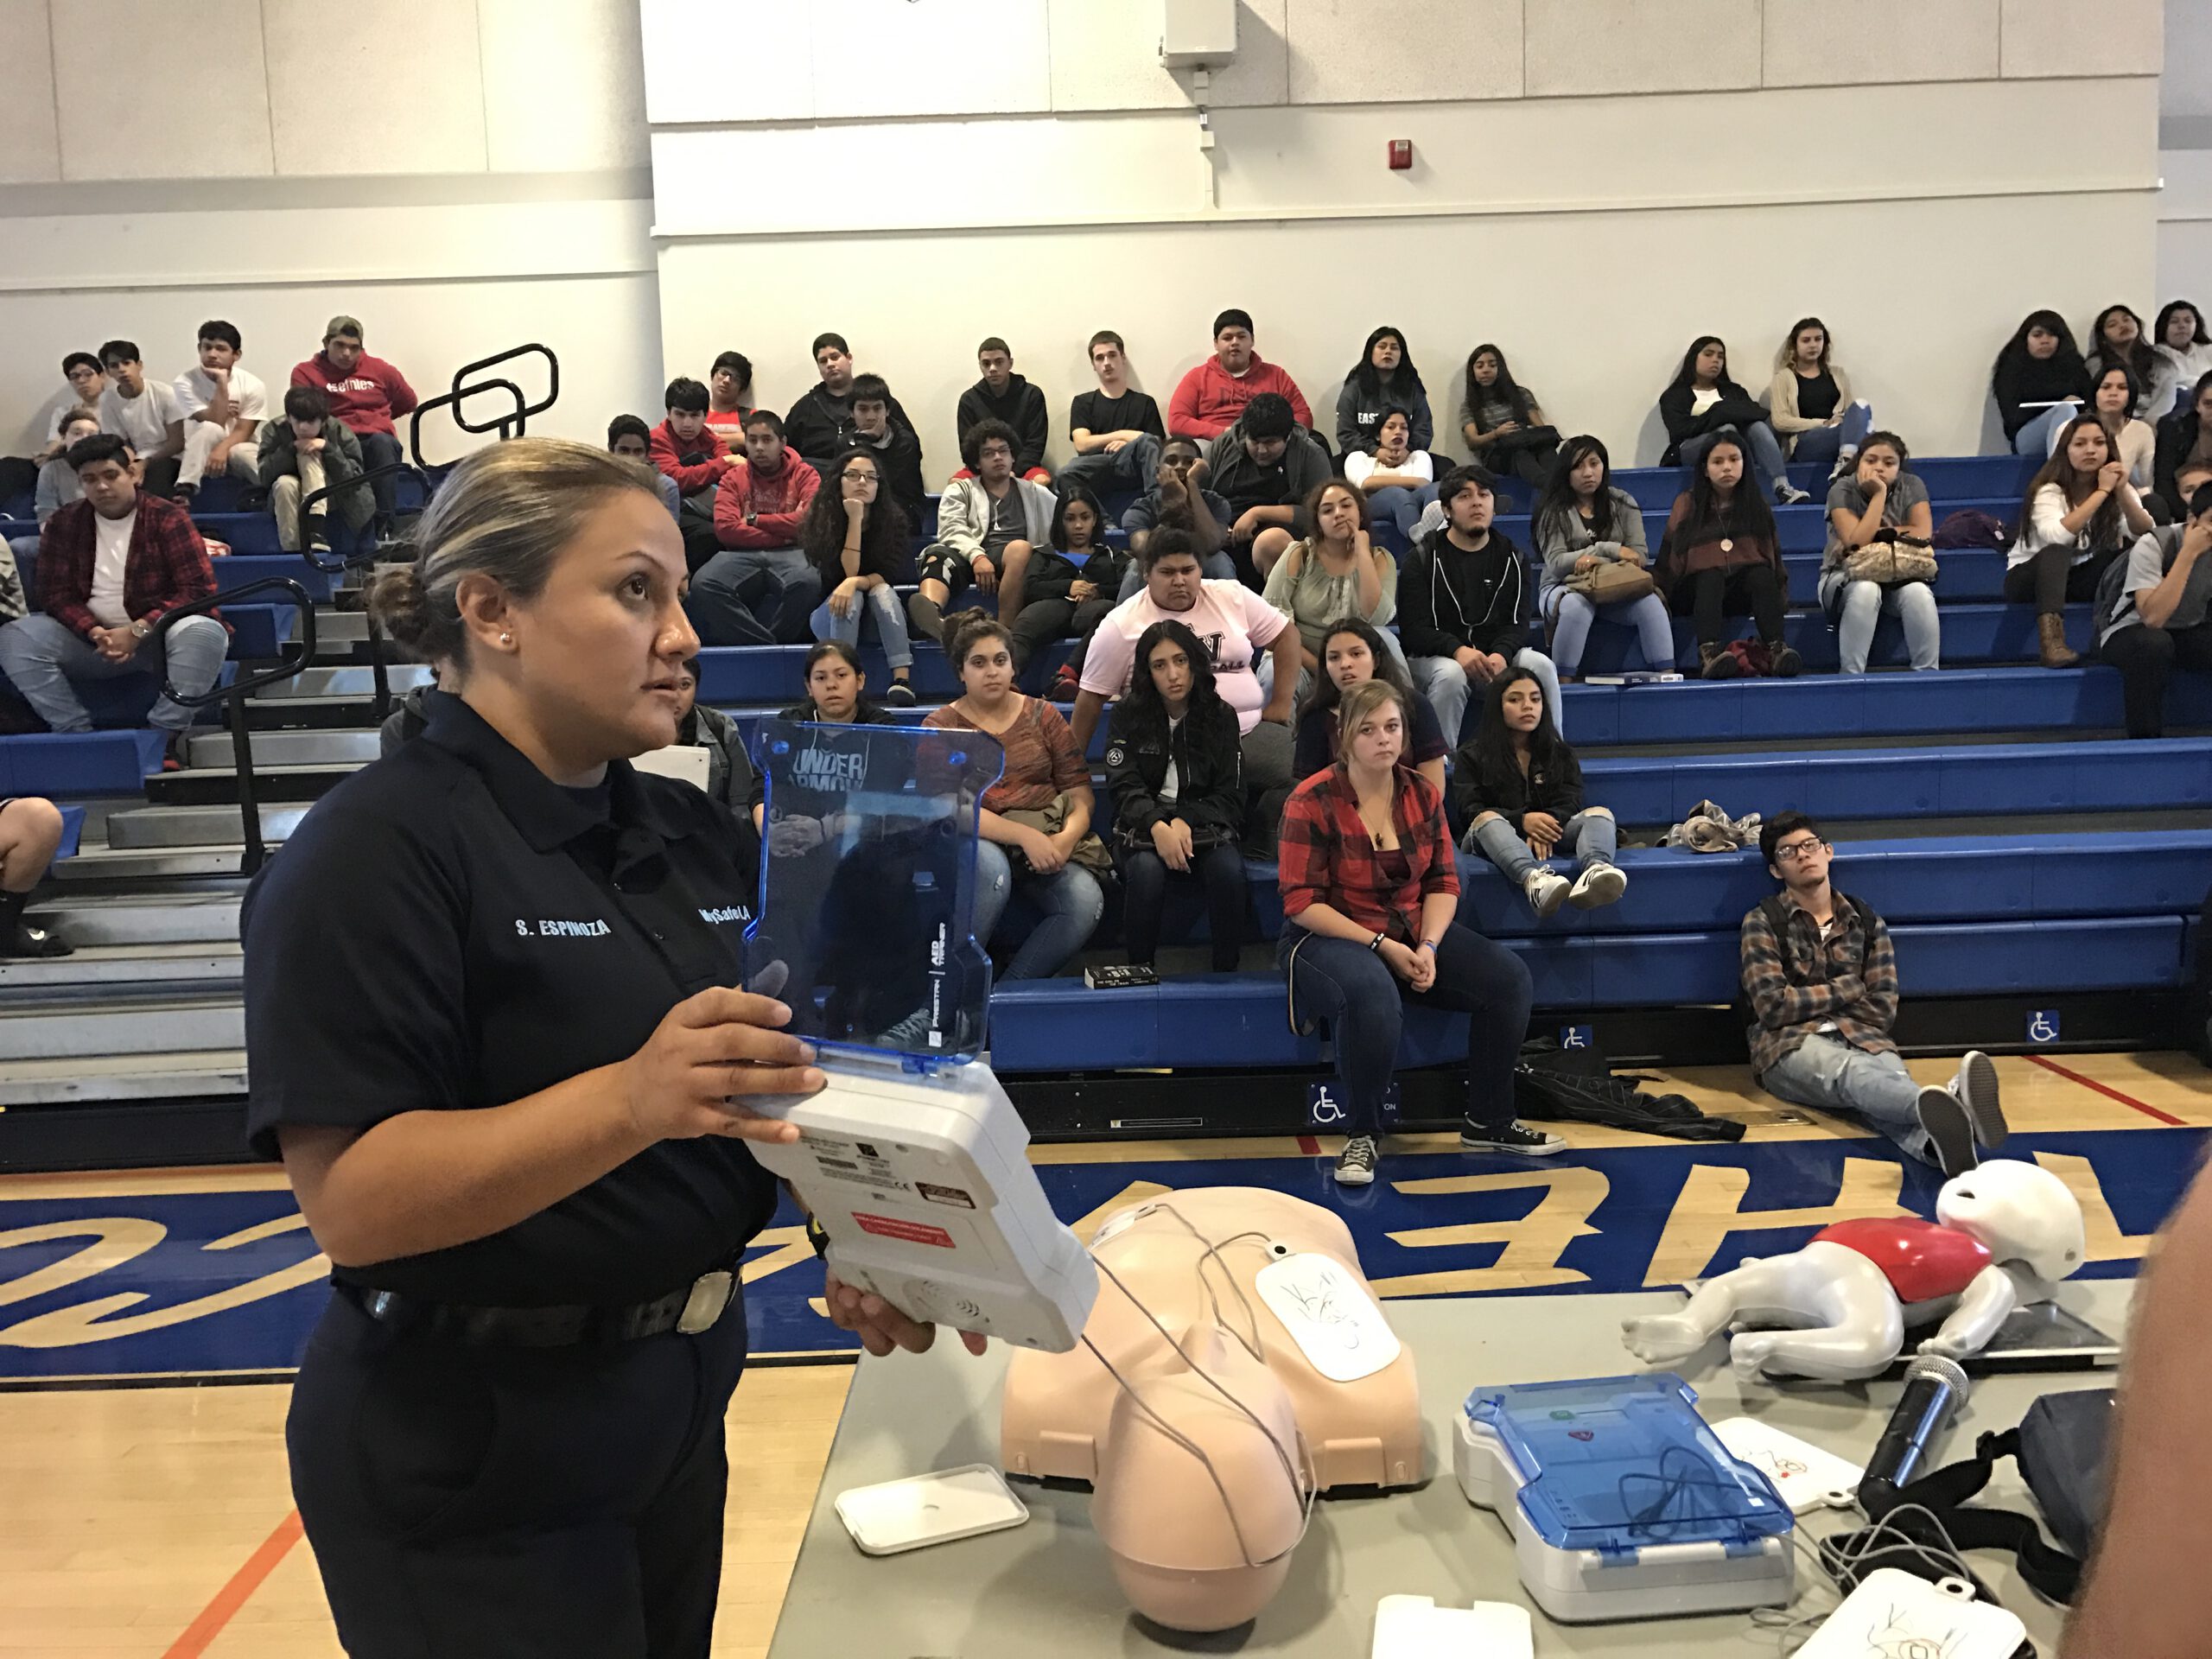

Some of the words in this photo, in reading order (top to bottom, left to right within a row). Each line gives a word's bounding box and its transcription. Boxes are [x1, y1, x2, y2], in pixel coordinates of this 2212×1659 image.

[792, 748, 863, 780] UNDER
[697, 905, 752, 925] MySafeLA
[515, 918, 535, 937] S.
[538, 918, 612, 938] ESPINOZA
[931, 940, 939, 966] AED
